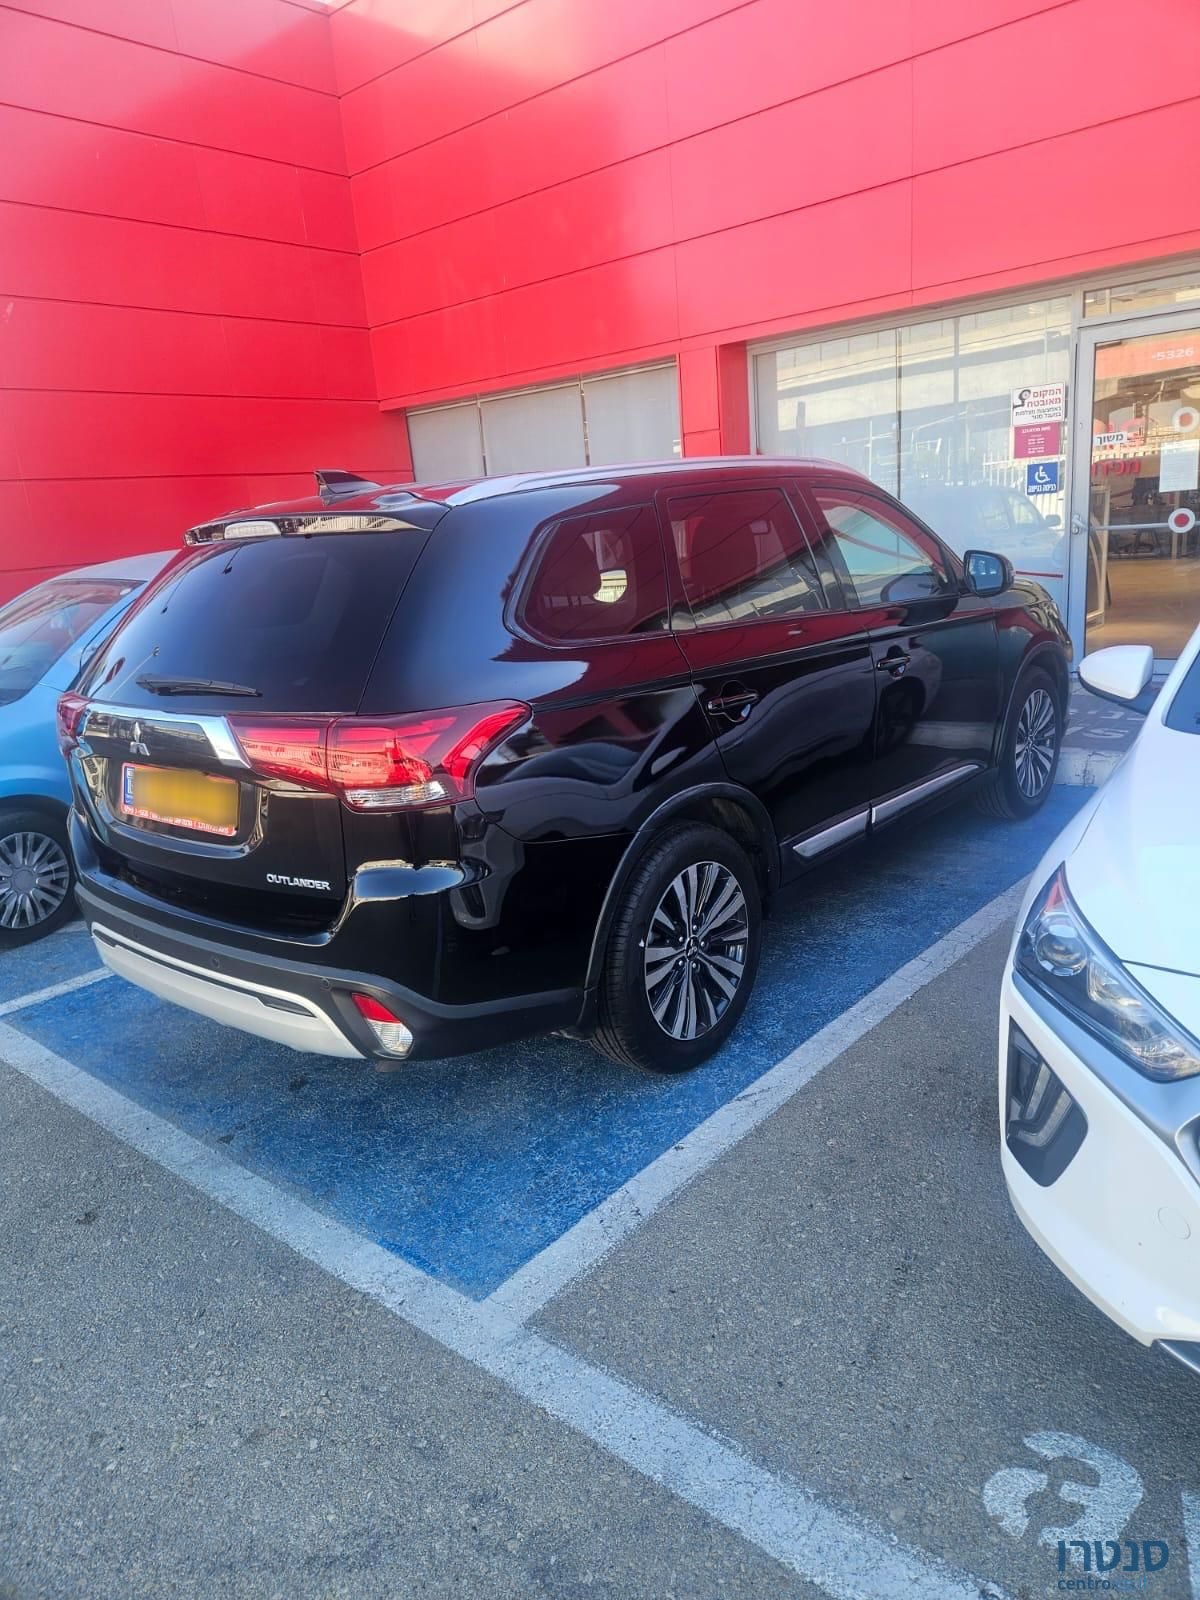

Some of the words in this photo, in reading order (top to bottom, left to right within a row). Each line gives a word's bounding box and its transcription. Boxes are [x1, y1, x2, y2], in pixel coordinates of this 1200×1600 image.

[1032, 388, 1061, 399] המקום
[1027, 397, 1061, 408] מאובטח
[1095, 433, 1124, 445] משוך
[266, 873, 331, 891] OUTLANDER
